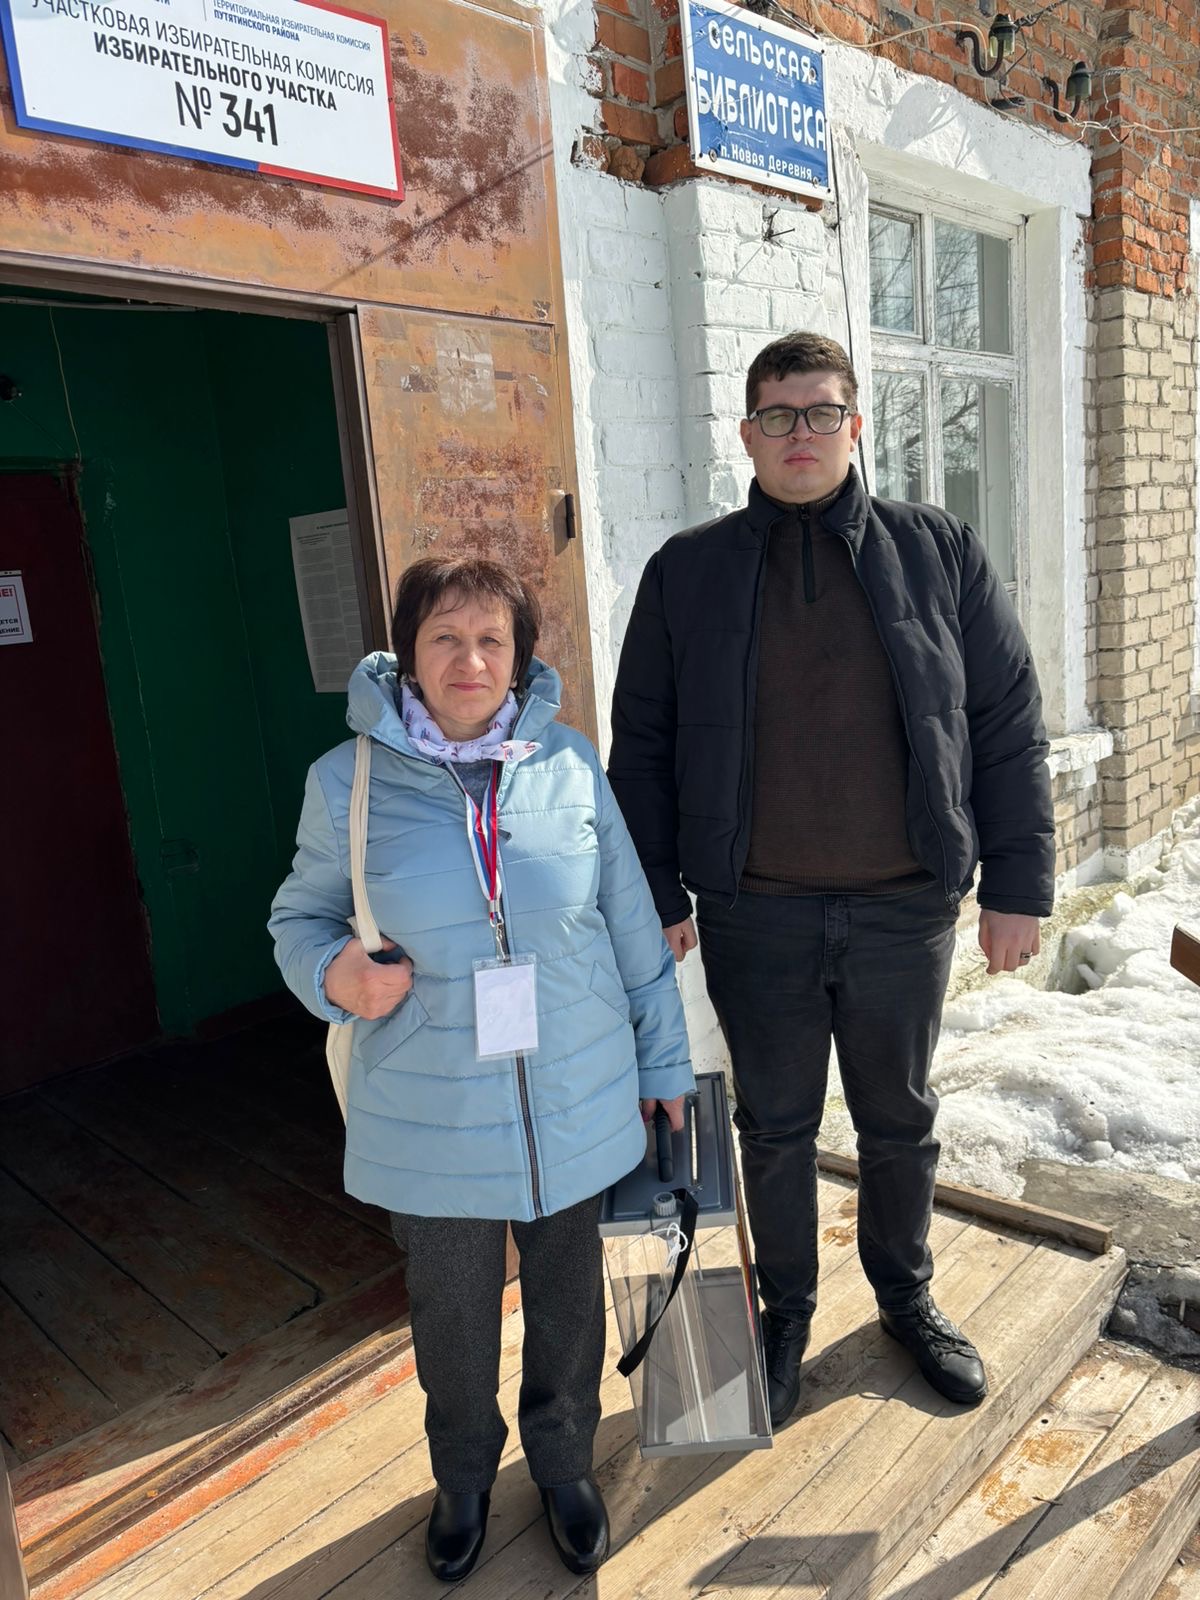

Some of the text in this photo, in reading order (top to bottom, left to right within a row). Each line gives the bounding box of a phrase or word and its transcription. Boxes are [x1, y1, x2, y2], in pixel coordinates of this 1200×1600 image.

[155, 20, 292, 74] ИЗБИРАТЕЛЬНАЯ
[295, 58, 375, 96] КОМИССИЯ
[213, 0, 371, 51] ТЕРРИТОРИАЛЬНАЯ ИЗБИРАТЕЛЬНАЯ КОМИССИЯ
[213, 9, 300, 42] ПУТЯТИНСКОГО РАЙОНА
[93, 31, 337, 111] ИЗБИРАТЕЛЬНОГО УЧАСТКА
[174, 81, 279, 147] № 341
